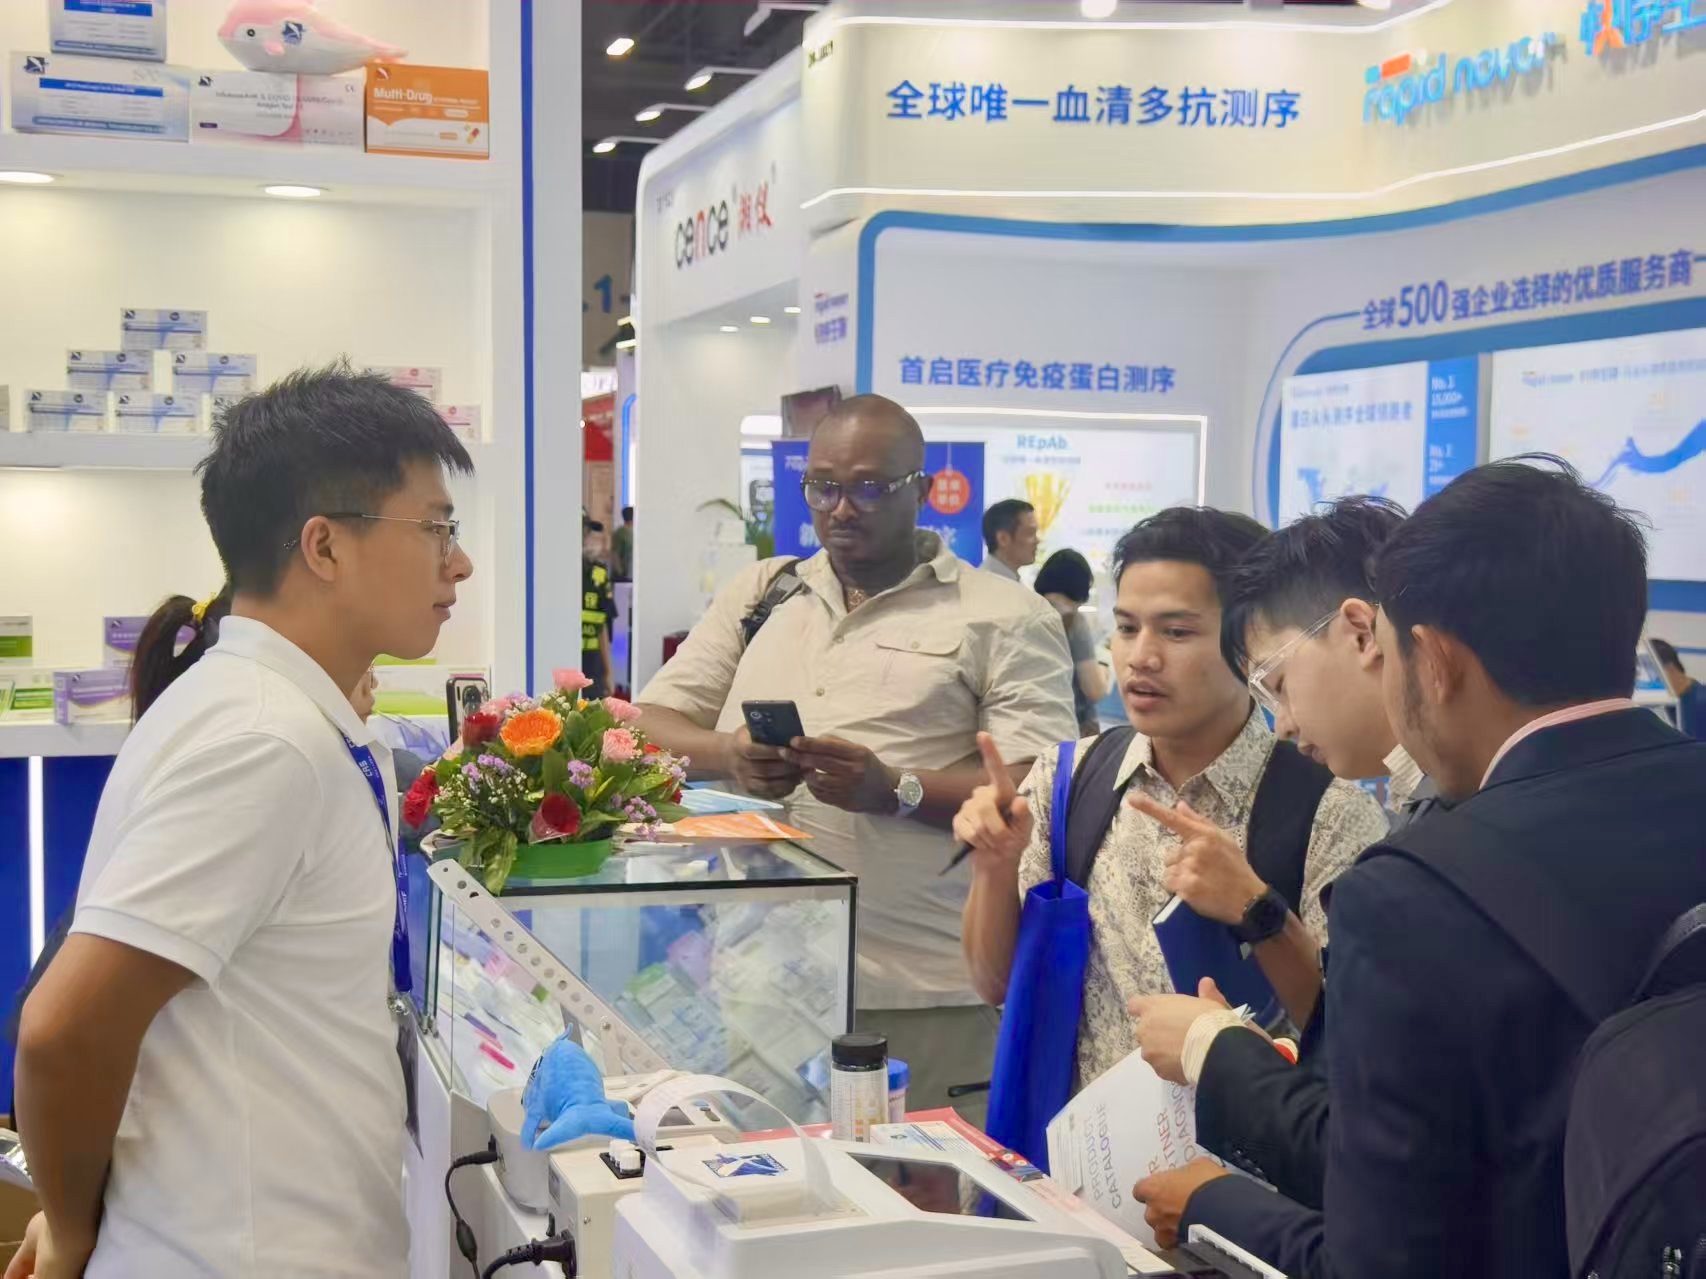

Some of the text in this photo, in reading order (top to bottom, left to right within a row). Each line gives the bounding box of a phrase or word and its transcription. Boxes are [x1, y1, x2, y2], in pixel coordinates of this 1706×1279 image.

[886, 79, 1302, 128] 全球唯一血清多抗测序
[675, 199, 729, 270] cence
[899, 356, 1176, 393] 首启医疗免疫蛋白测序
[1016, 434, 1068, 451] REpAb
